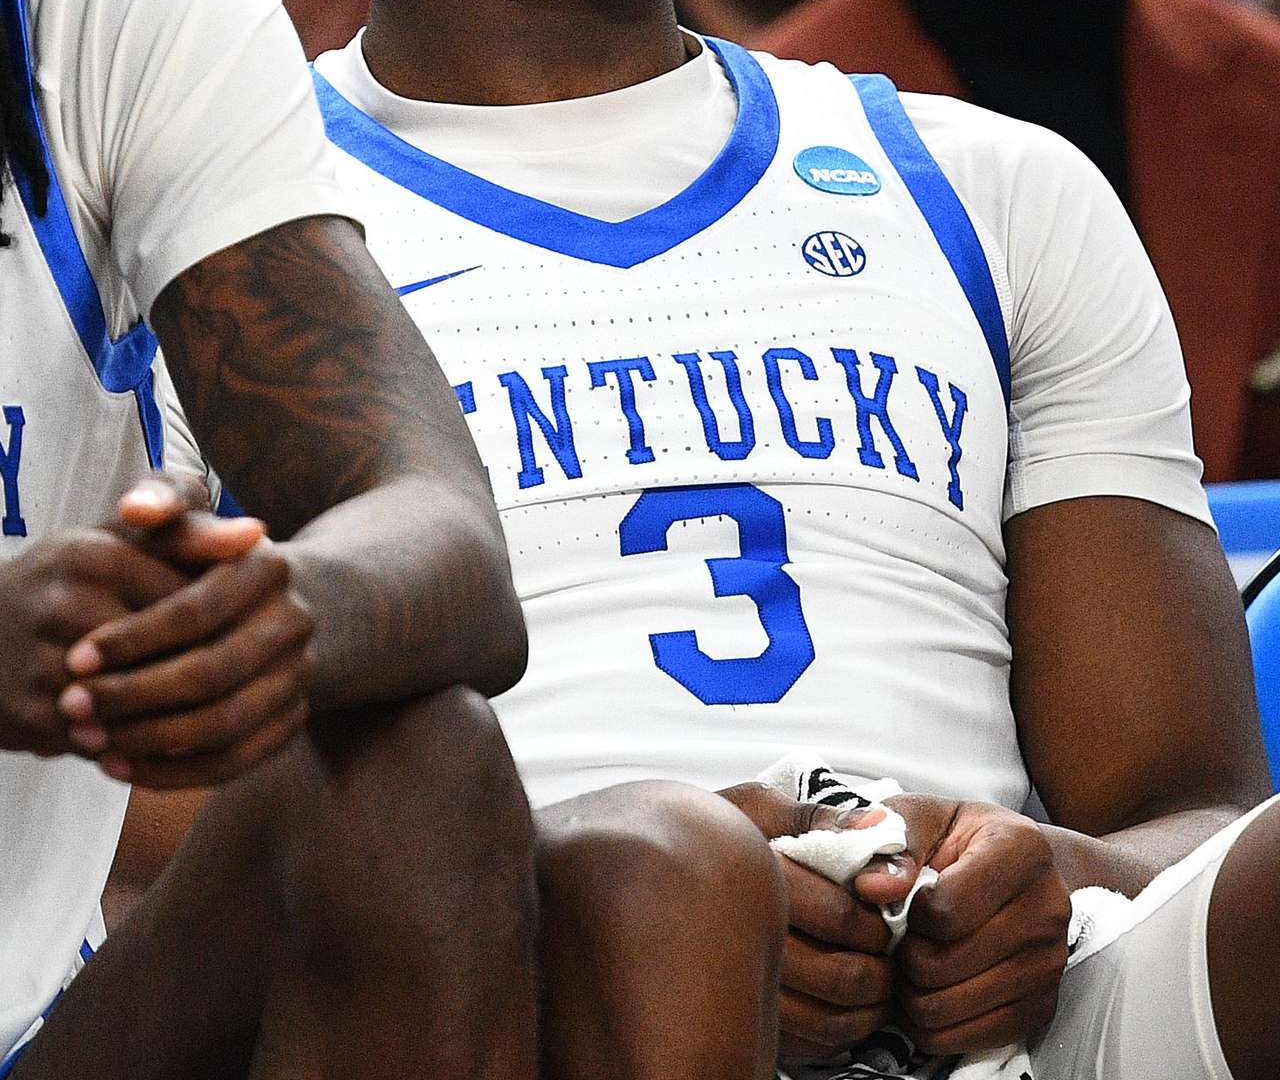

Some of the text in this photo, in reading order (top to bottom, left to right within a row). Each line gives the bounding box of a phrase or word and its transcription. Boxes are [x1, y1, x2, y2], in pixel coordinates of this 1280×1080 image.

[808, 167, 878, 186] NCAA
[804, 231, 866, 277] SEC
[454, 348, 968, 511] NTUCKY
[620, 482, 816, 706] 3
